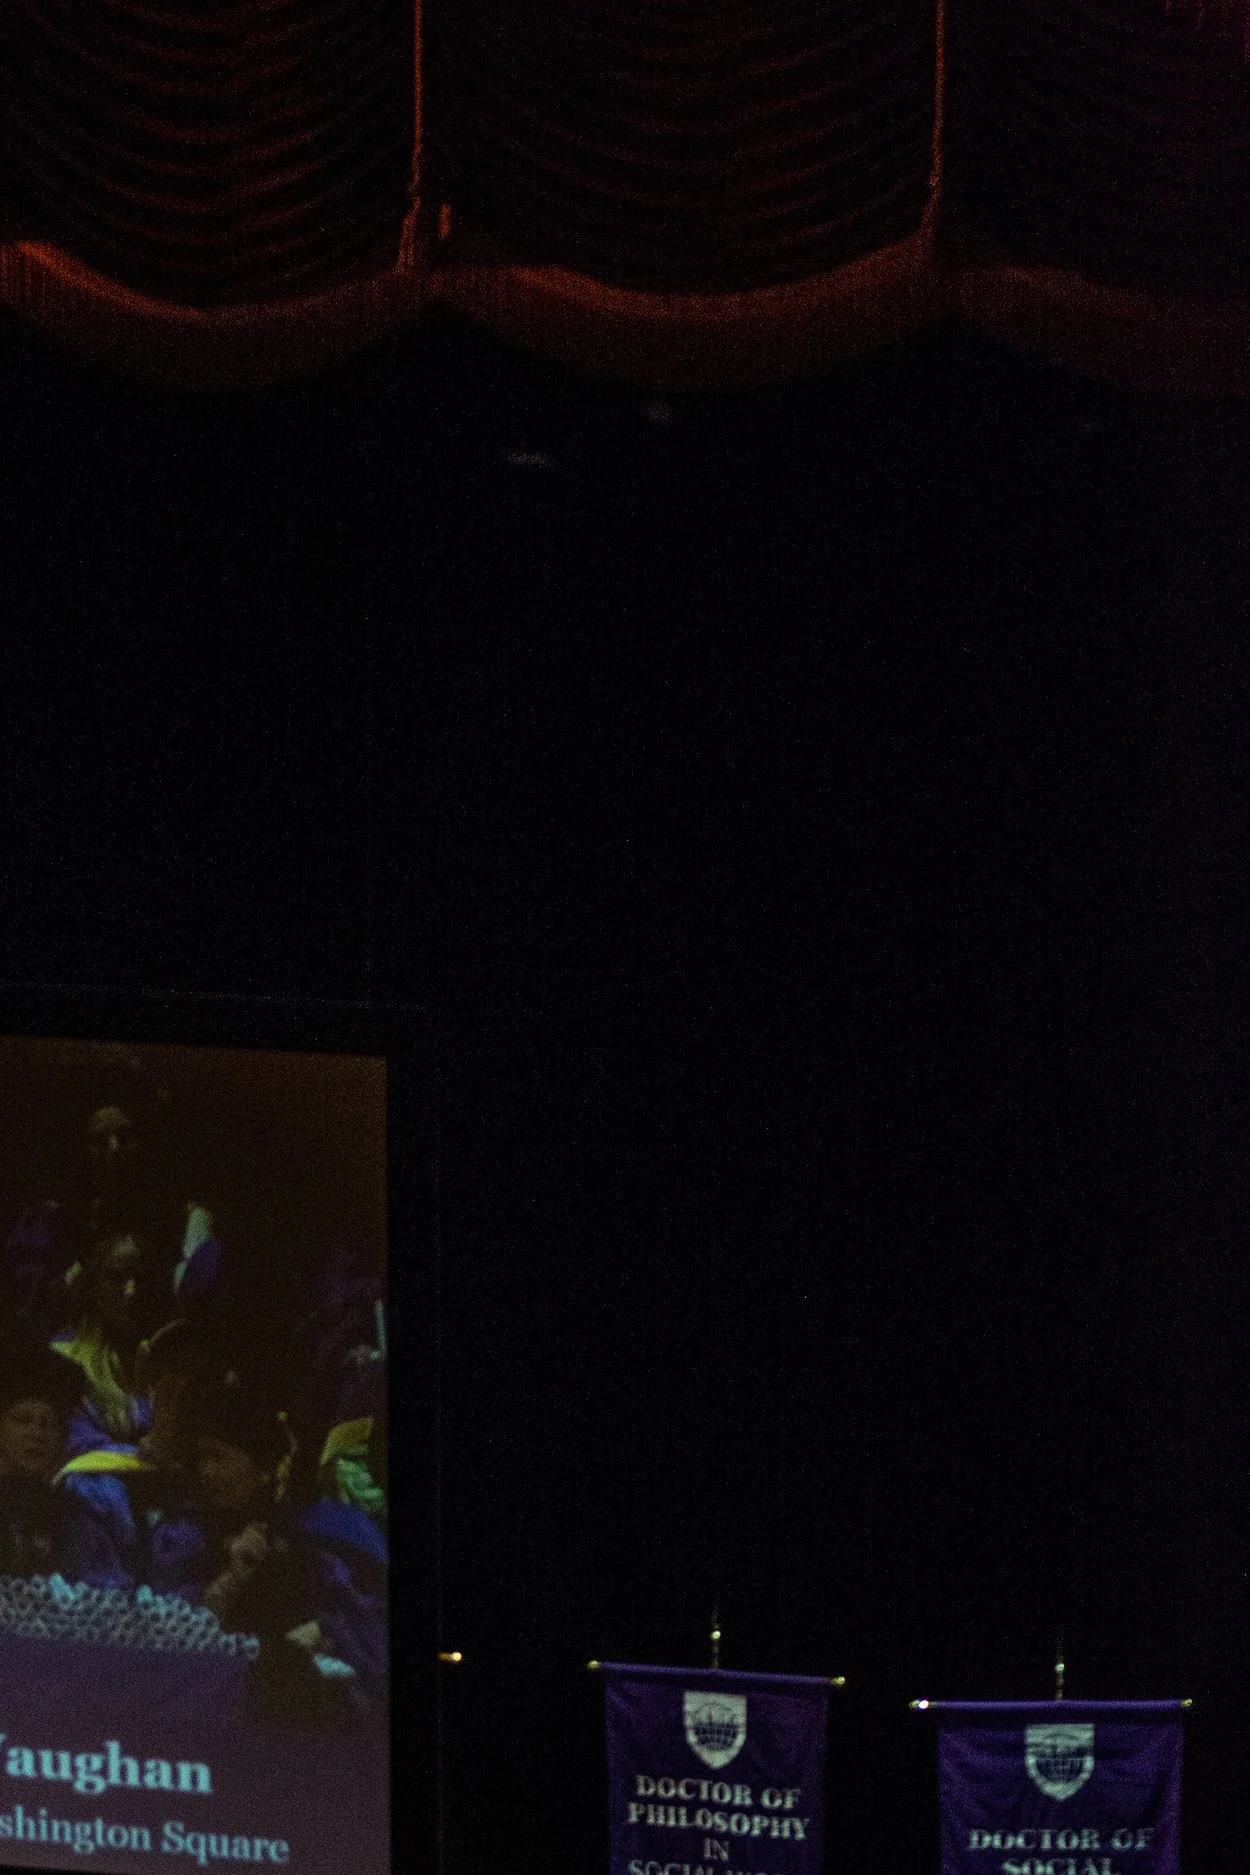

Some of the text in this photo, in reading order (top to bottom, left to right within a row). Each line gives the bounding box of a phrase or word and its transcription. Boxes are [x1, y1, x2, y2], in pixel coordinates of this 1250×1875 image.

[635, 1774, 801, 1810] DOCTOR OF
[627, 1802, 810, 1840] PHILOSOPHY
[967, 1826, 1155, 1852] DOCTOR OF
[160, 1820, 290, 1865] Square
[703, 1837, 730, 1861] IN
